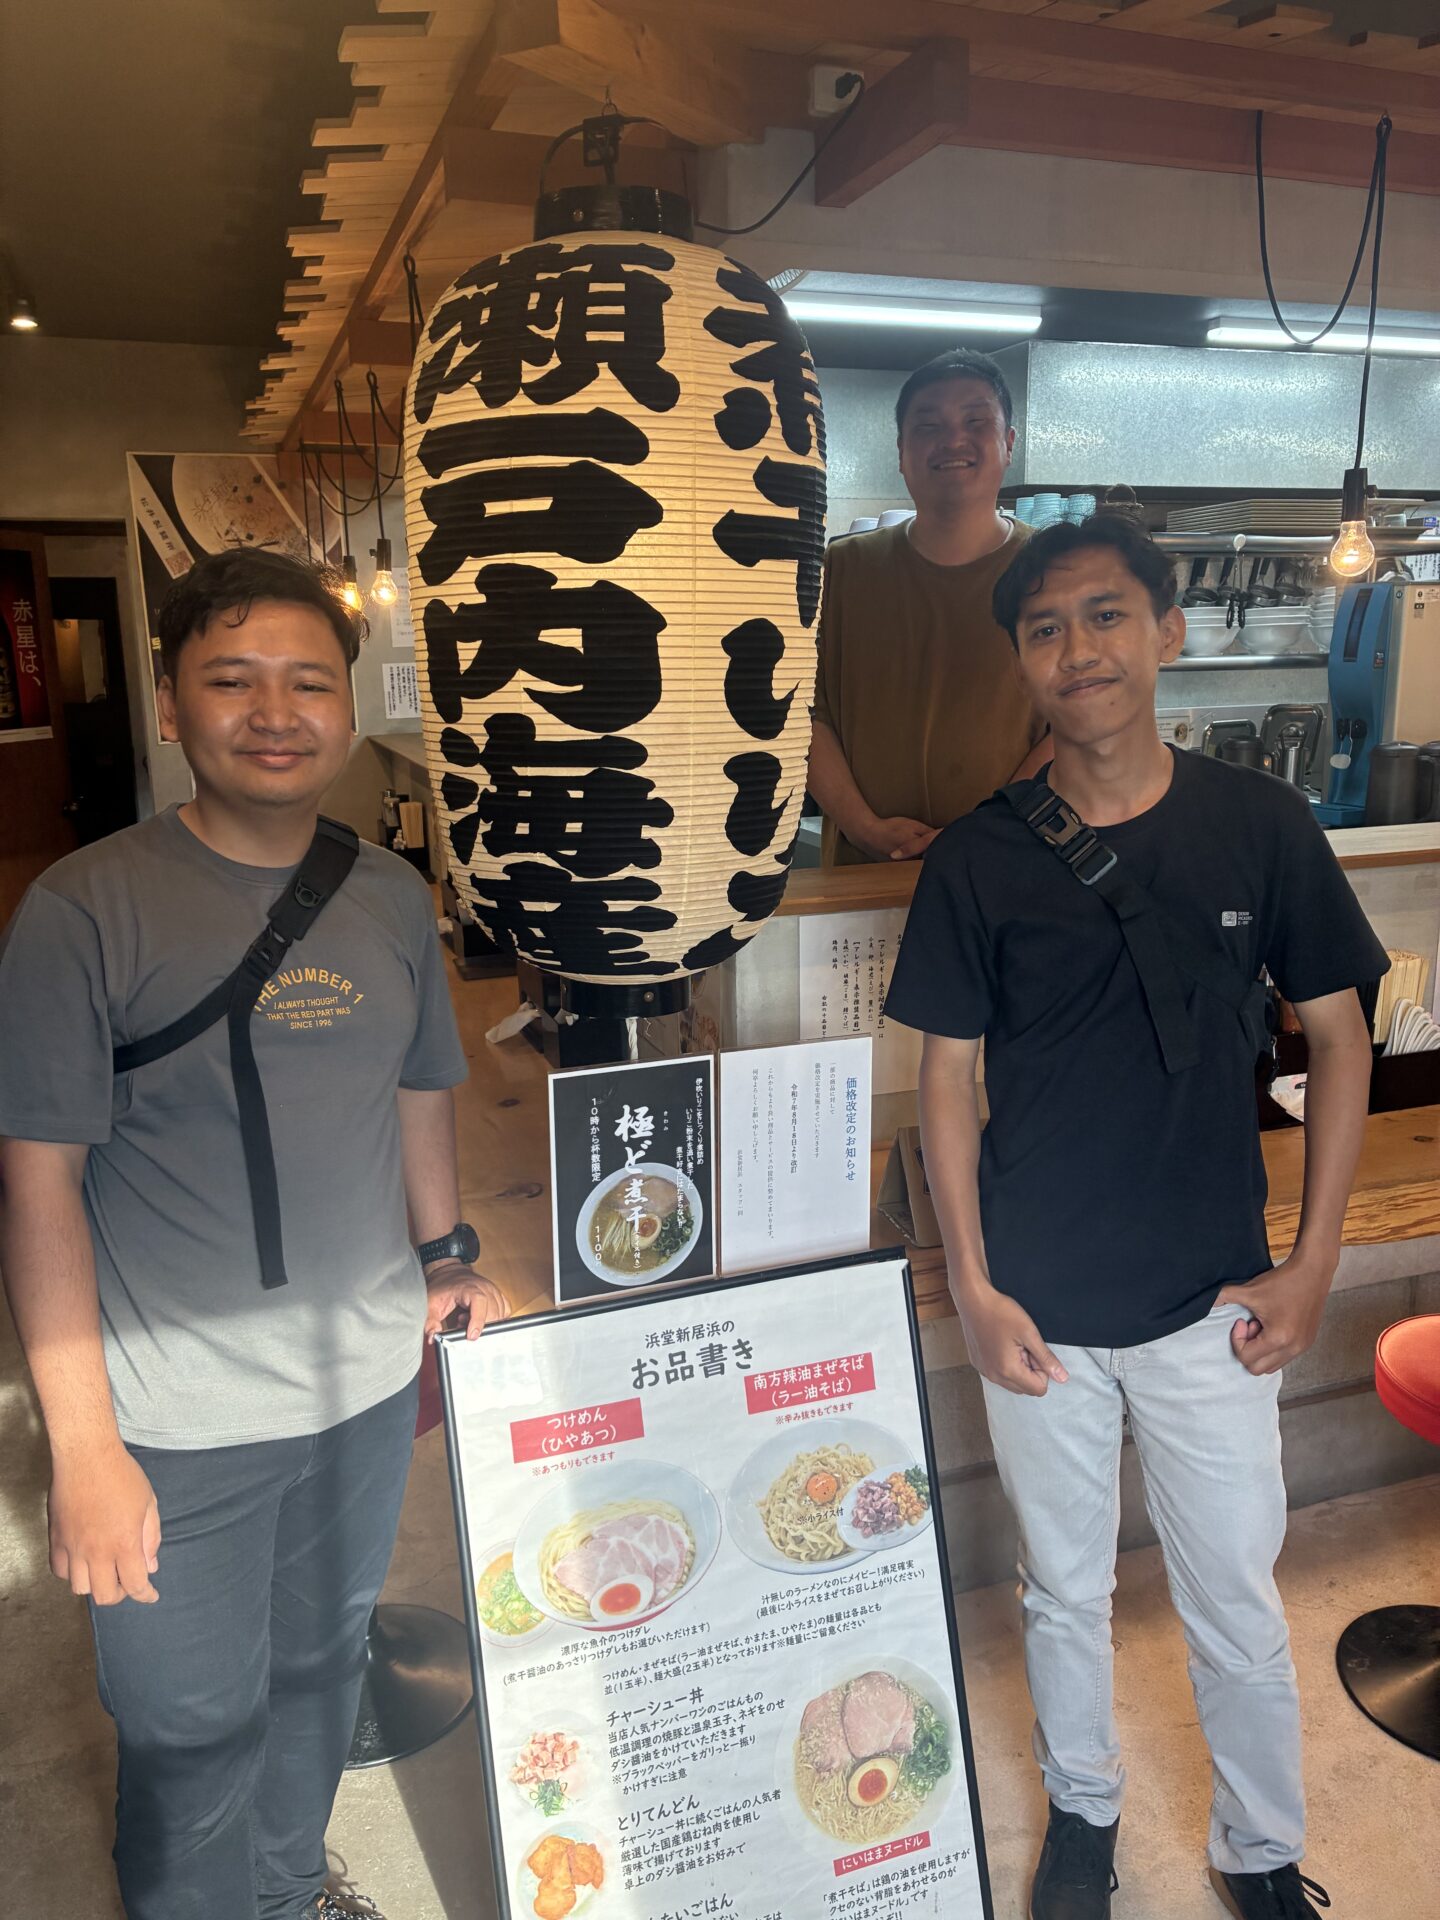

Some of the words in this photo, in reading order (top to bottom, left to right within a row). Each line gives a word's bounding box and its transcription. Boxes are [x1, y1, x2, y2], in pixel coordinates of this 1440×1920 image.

[12, 598, 41, 687] 赤星は、
[277, 967, 353, 995] NUMBER
[353, 993, 364, 1005] 1
[277, 999, 306, 1010] ALWAYS
[306, 996, 339, 1006] THOUGHT
[266, 1012, 285, 1021] THAT
[286, 1011, 301, 1020] THE
[301, 1010, 316, 1019] RED
[317, 1008, 334, 1018] PART
[335, 1006, 351, 1015] WAS
[290, 1020, 313, 1030] SINCE
[845, 1077, 858, 1181] 価格改定のお知らせ
[614, 1104, 656, 1232] 極ど煮干
[645, 1320, 735, 1349] 浜堂新居浜の
[631, 1338, 754, 1390] お品書き
[753, 1354, 865, 1391] 南方辣油まぜそば
[771, 1377, 852, 1408] (ラー油そば)
[547, 1407, 608, 1430] つけめん
[775, 1401, 854, 1425] ※辛み抜きもできます
[541, 1424, 617, 1454] (ひやあつ)
[532, 1450, 616, 1476] ※あつもりもできます
[560, 1626, 652, 1657] 濃厚な魚介のつけダレ
[606, 1686, 705, 1728] チャーシュー丼
[611, 1724, 746, 1773] ダシ醤油をかけていただきます
[623, 1767, 688, 1795] かけすぎに注意
[618, 1794, 700, 1831] とりてんどん
[619, 1789, 782, 1848] チャーシュー丼に続くごはんの人気者
[620, 1810, 761, 1863] 厳選した国産鶏むね肉を使用し
[842, 1836, 924, 1871] にいはまヌードル
[622, 1837, 721, 1877] 薄味で揚げております
[625, 1842, 747, 1891] 卓上のダシ醤油をお好みで
[823, 1847, 971, 1904] 「煮干そば」は鶏の油を使用しますが
[829, 1865, 957, 1916] クセのない背脂をあわせるのが
